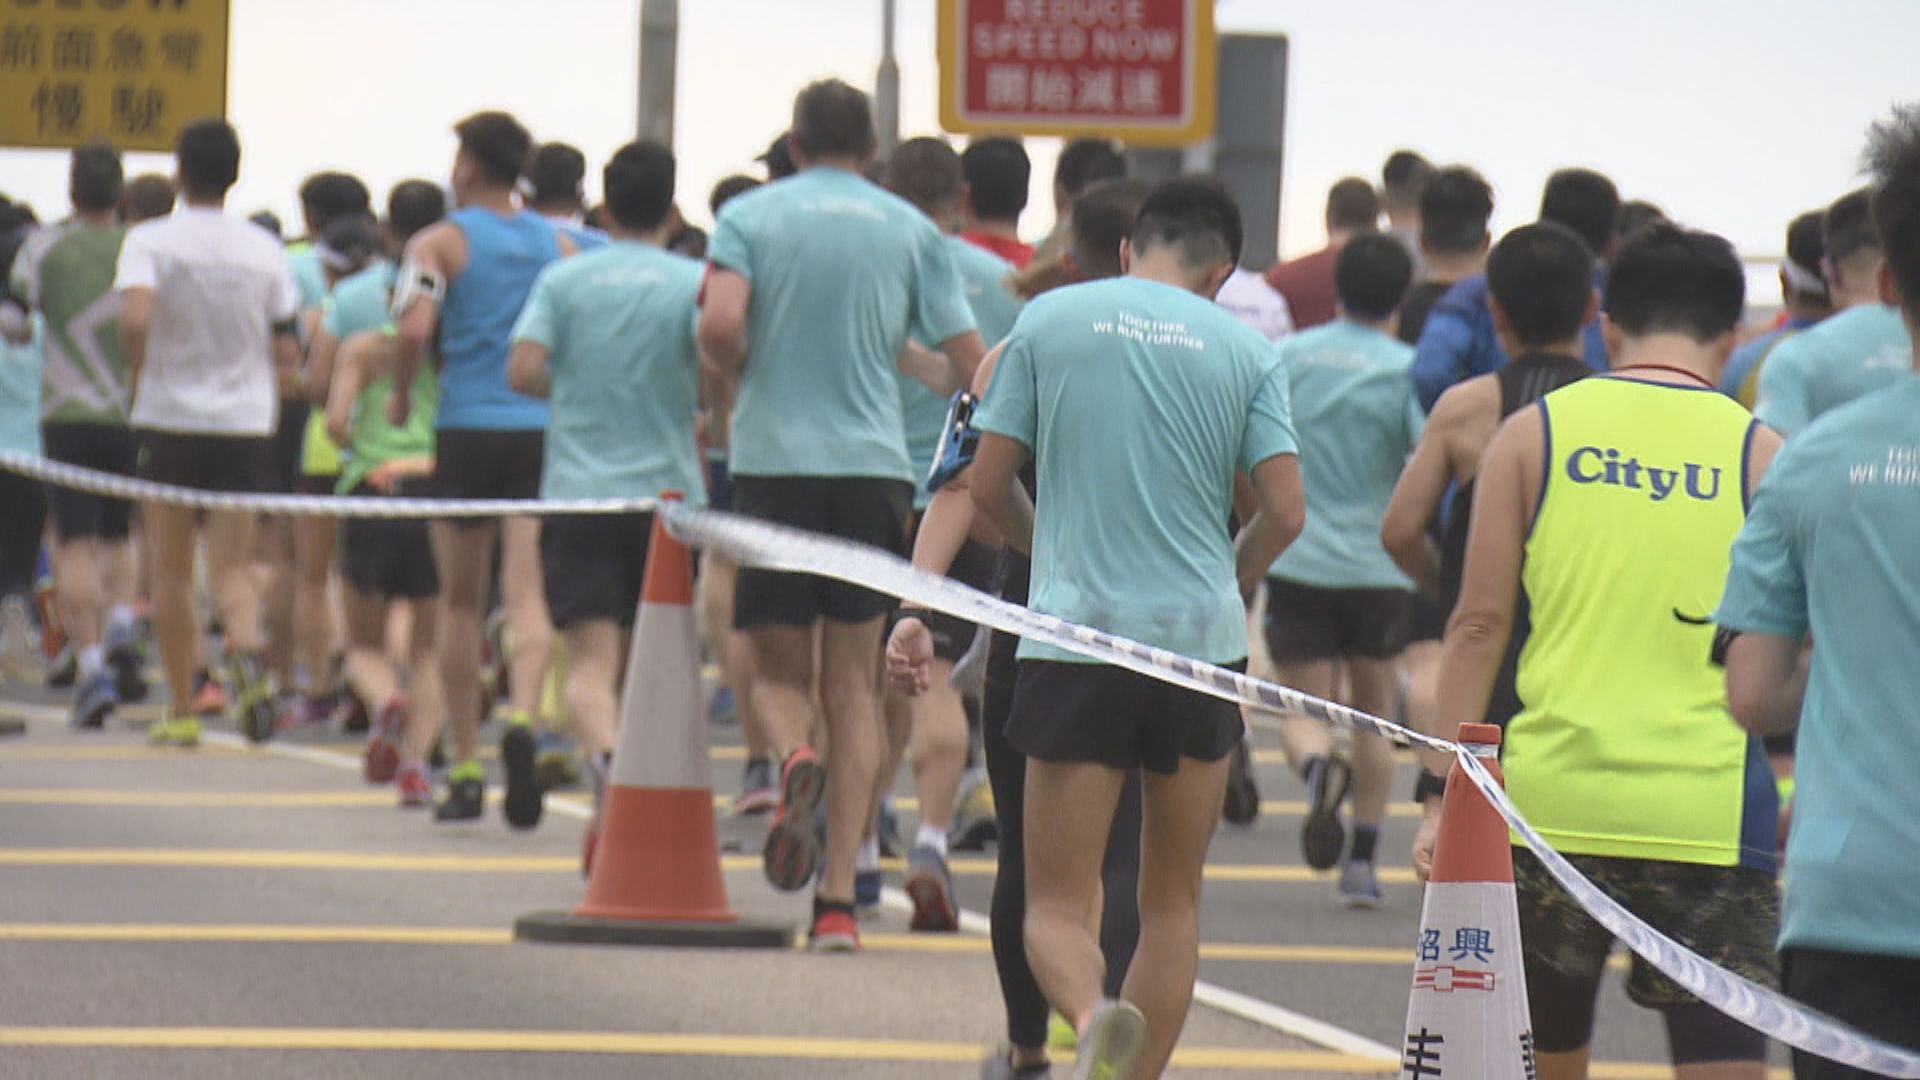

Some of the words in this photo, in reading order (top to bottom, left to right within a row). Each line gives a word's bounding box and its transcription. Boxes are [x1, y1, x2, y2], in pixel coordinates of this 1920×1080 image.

[1004, 0, 1146, 26] REDUCE
[973, 22, 1087, 59] SPEED
[1091, 26, 1177, 61] NOW
[1092, 320, 1113, 334] WE
[1117, 323, 1144, 342] RUN
[1146, 333, 1205, 350] FURTHER
[1566, 445, 1722, 501] CityU
[1849, 463, 1878, 484] WE
